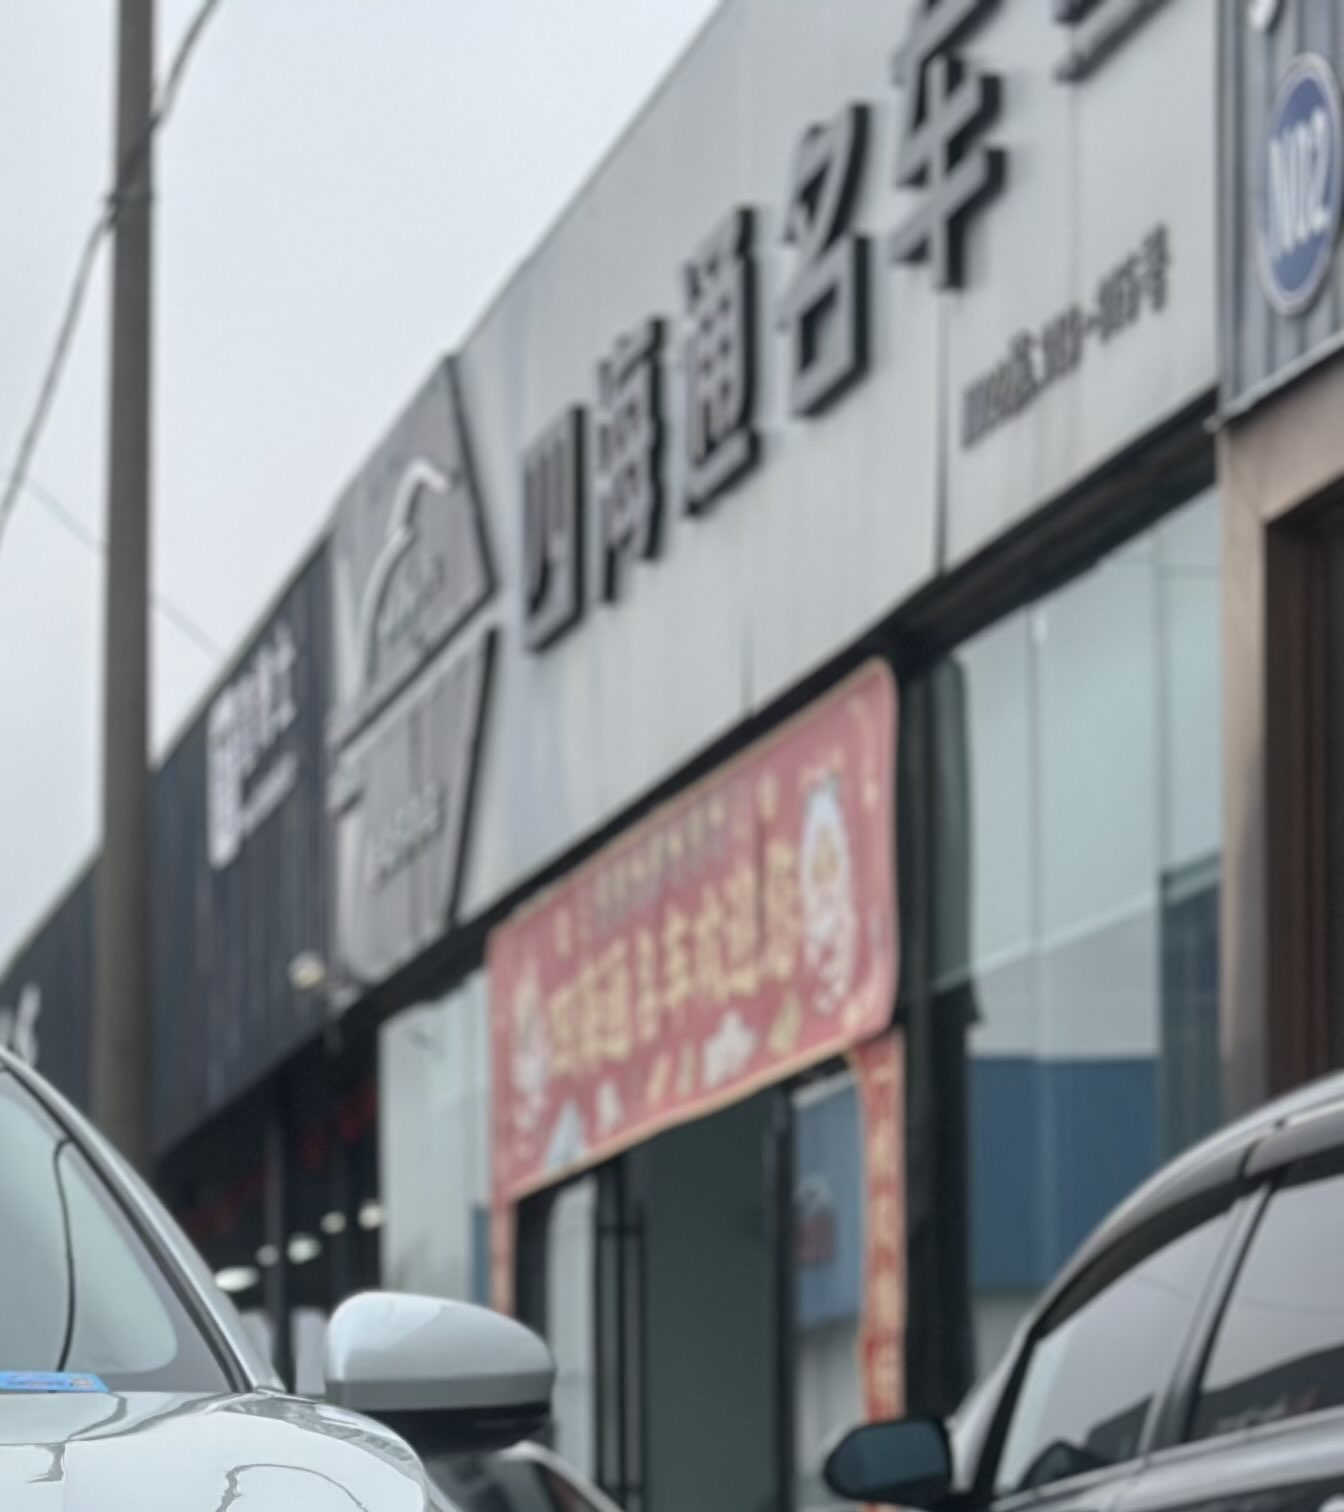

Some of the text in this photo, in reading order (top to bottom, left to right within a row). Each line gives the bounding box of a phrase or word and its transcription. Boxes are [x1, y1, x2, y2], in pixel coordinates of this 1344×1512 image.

[520, 0, 1177, 656] 四海通名车
